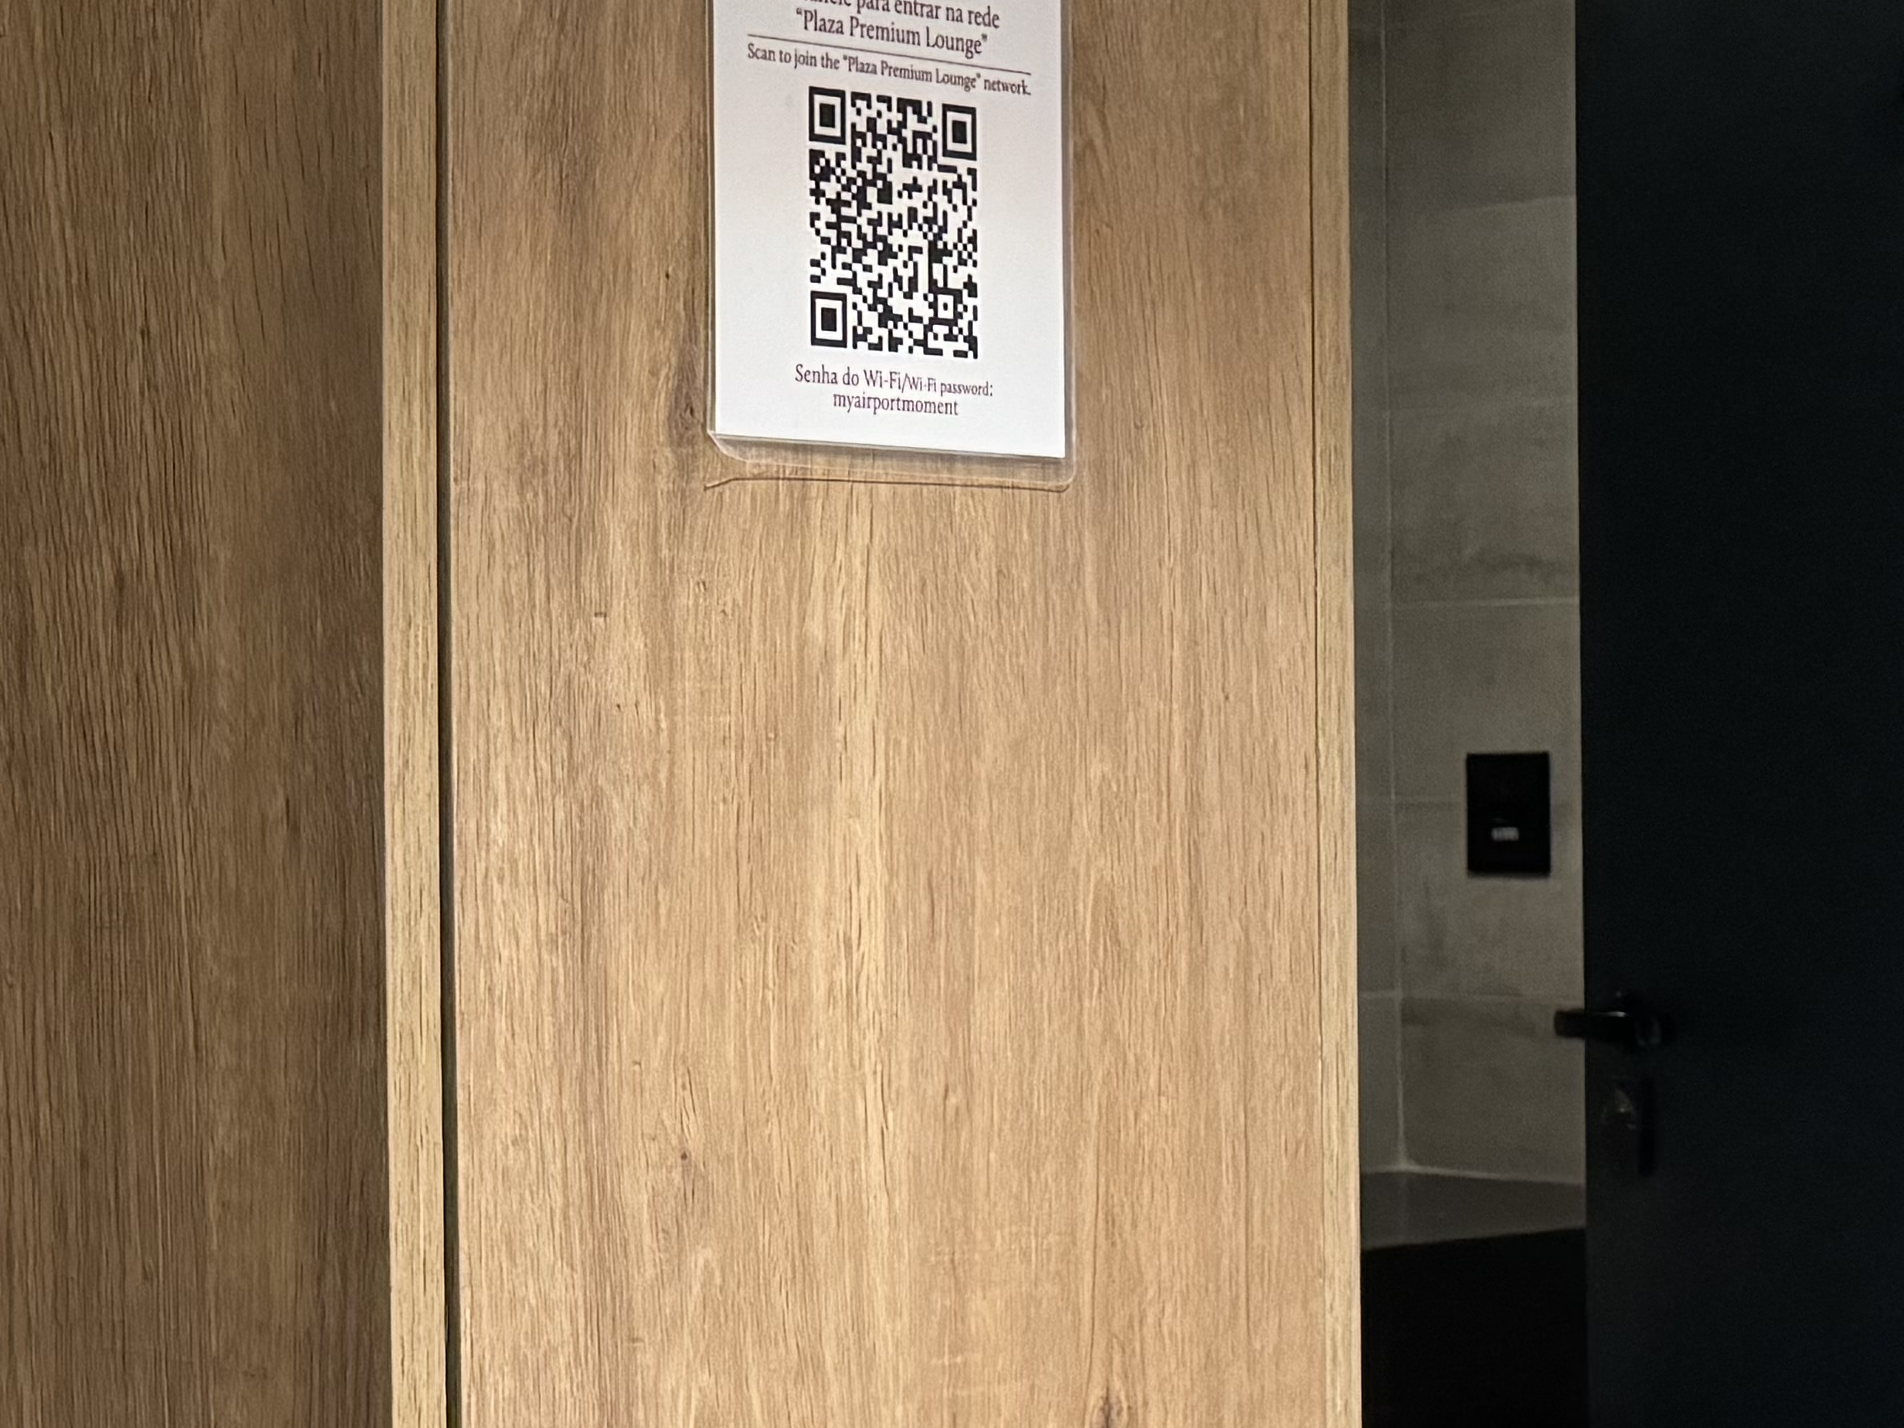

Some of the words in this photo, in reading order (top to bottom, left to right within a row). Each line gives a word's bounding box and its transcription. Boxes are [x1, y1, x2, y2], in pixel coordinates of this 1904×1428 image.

[849, 15, 921, 47] Premium
[945, 5, 963, 23] na
[967, 5, 1000, 29] rede
[747, 42, 776, 62] Scan
[778, 50, 792, 64] to
[793, 48, 817, 69] join
[820, 51, 841, 70] the
[880, 59, 933, 83] Premium
[983, 78, 1032, 96] network.
[794, 363, 838, 385] Senha
[842, 365, 860, 386] do
[940, 380, 993, 397] password:
[833, 390, 959, 416] myairportmoment
